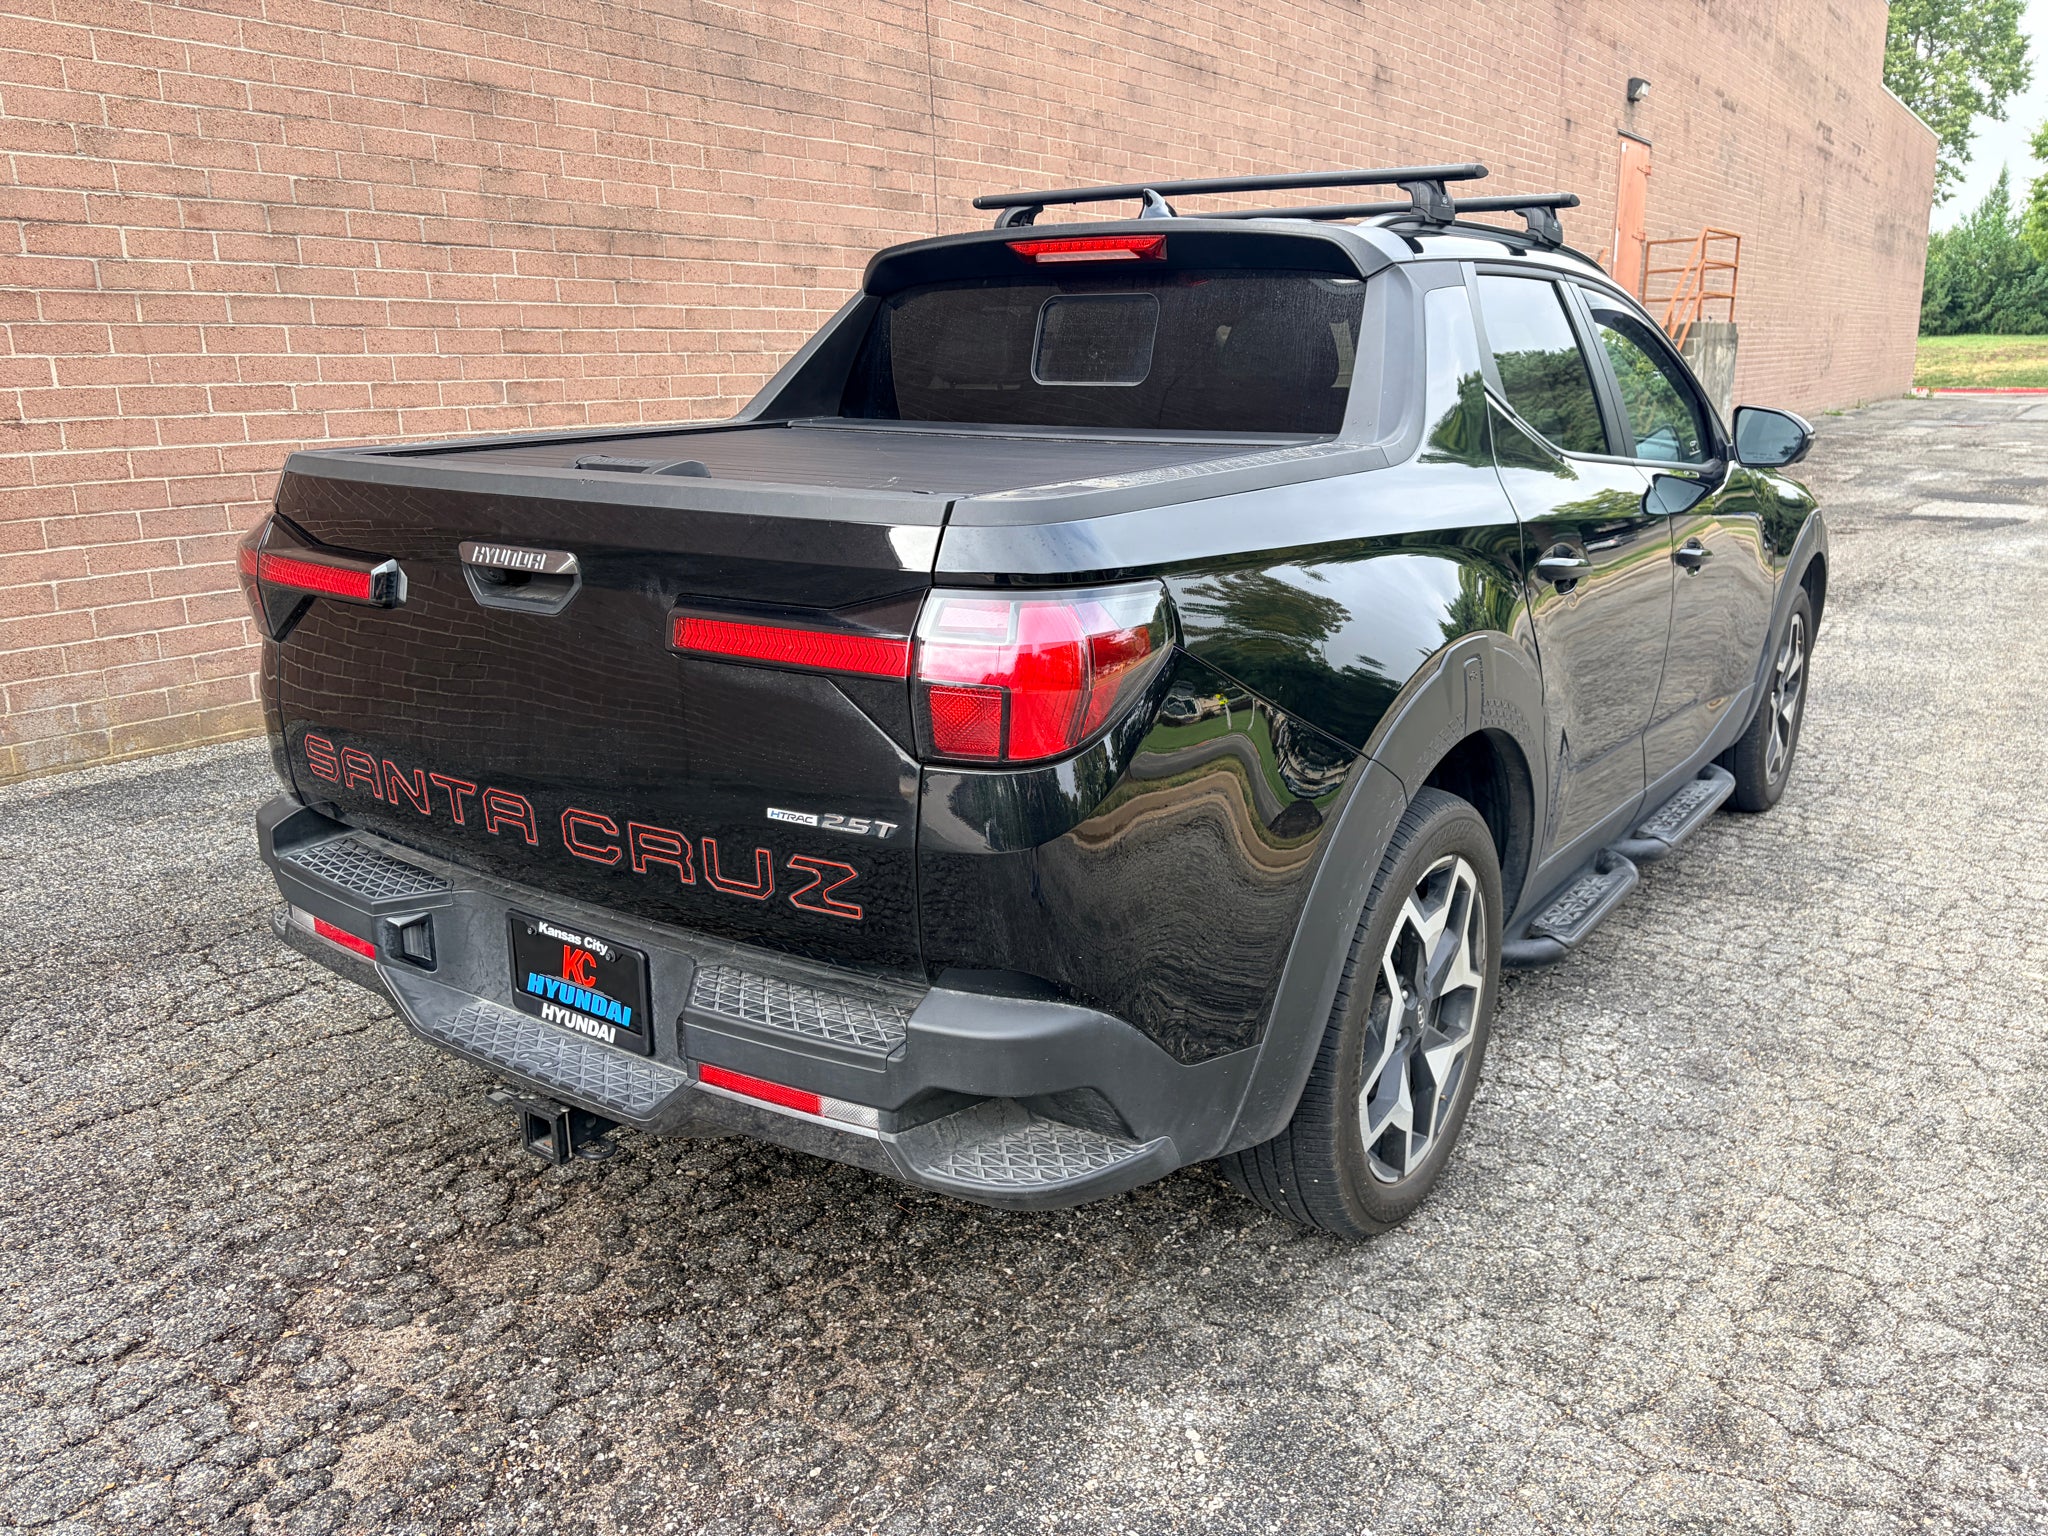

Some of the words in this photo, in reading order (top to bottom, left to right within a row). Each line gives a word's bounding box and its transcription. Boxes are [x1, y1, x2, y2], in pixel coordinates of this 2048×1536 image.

[472, 545, 547, 570] HYUNDAI
[304, 734, 538, 845] SANTA
[562, 808, 863, 919] CRUZ
[769, 809, 814, 825] HTRAC
[538, 921, 582, 946] Kansas
[583, 937, 609, 956] City
[562, 944, 597, 988] KC
[526, 972, 632, 1027] HYUNDAI
[541, 1003, 616, 1043] HYUNDAI
